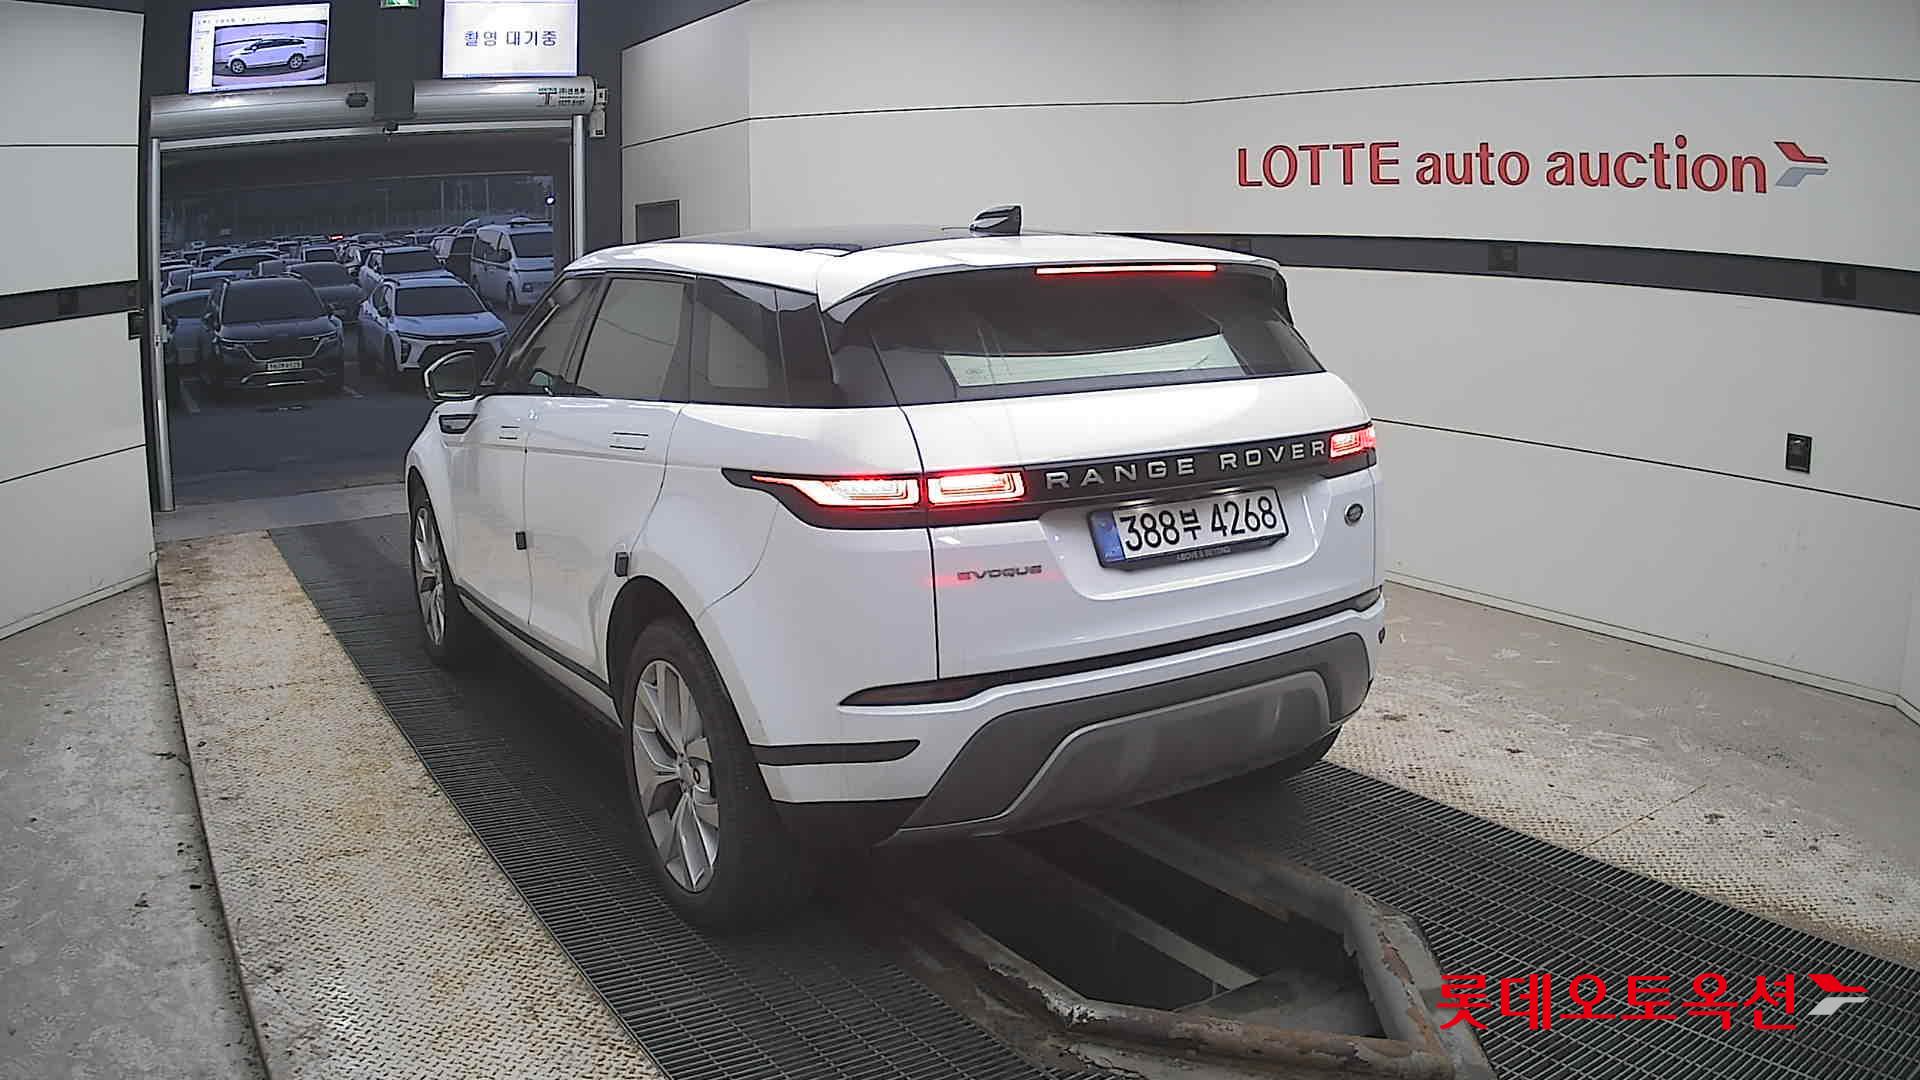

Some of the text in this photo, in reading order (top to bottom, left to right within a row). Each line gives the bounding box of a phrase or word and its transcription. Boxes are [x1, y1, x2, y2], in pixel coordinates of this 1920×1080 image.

[505, 30, 558, 47] 대기중
[1237, 134, 1768, 194] LOTTE auto auction
[1046, 440, 1325, 489] RANGE ROVER
[1120, 496, 1277, 551] 388부 4268
[957, 565, 1042, 581] EVOQUE
